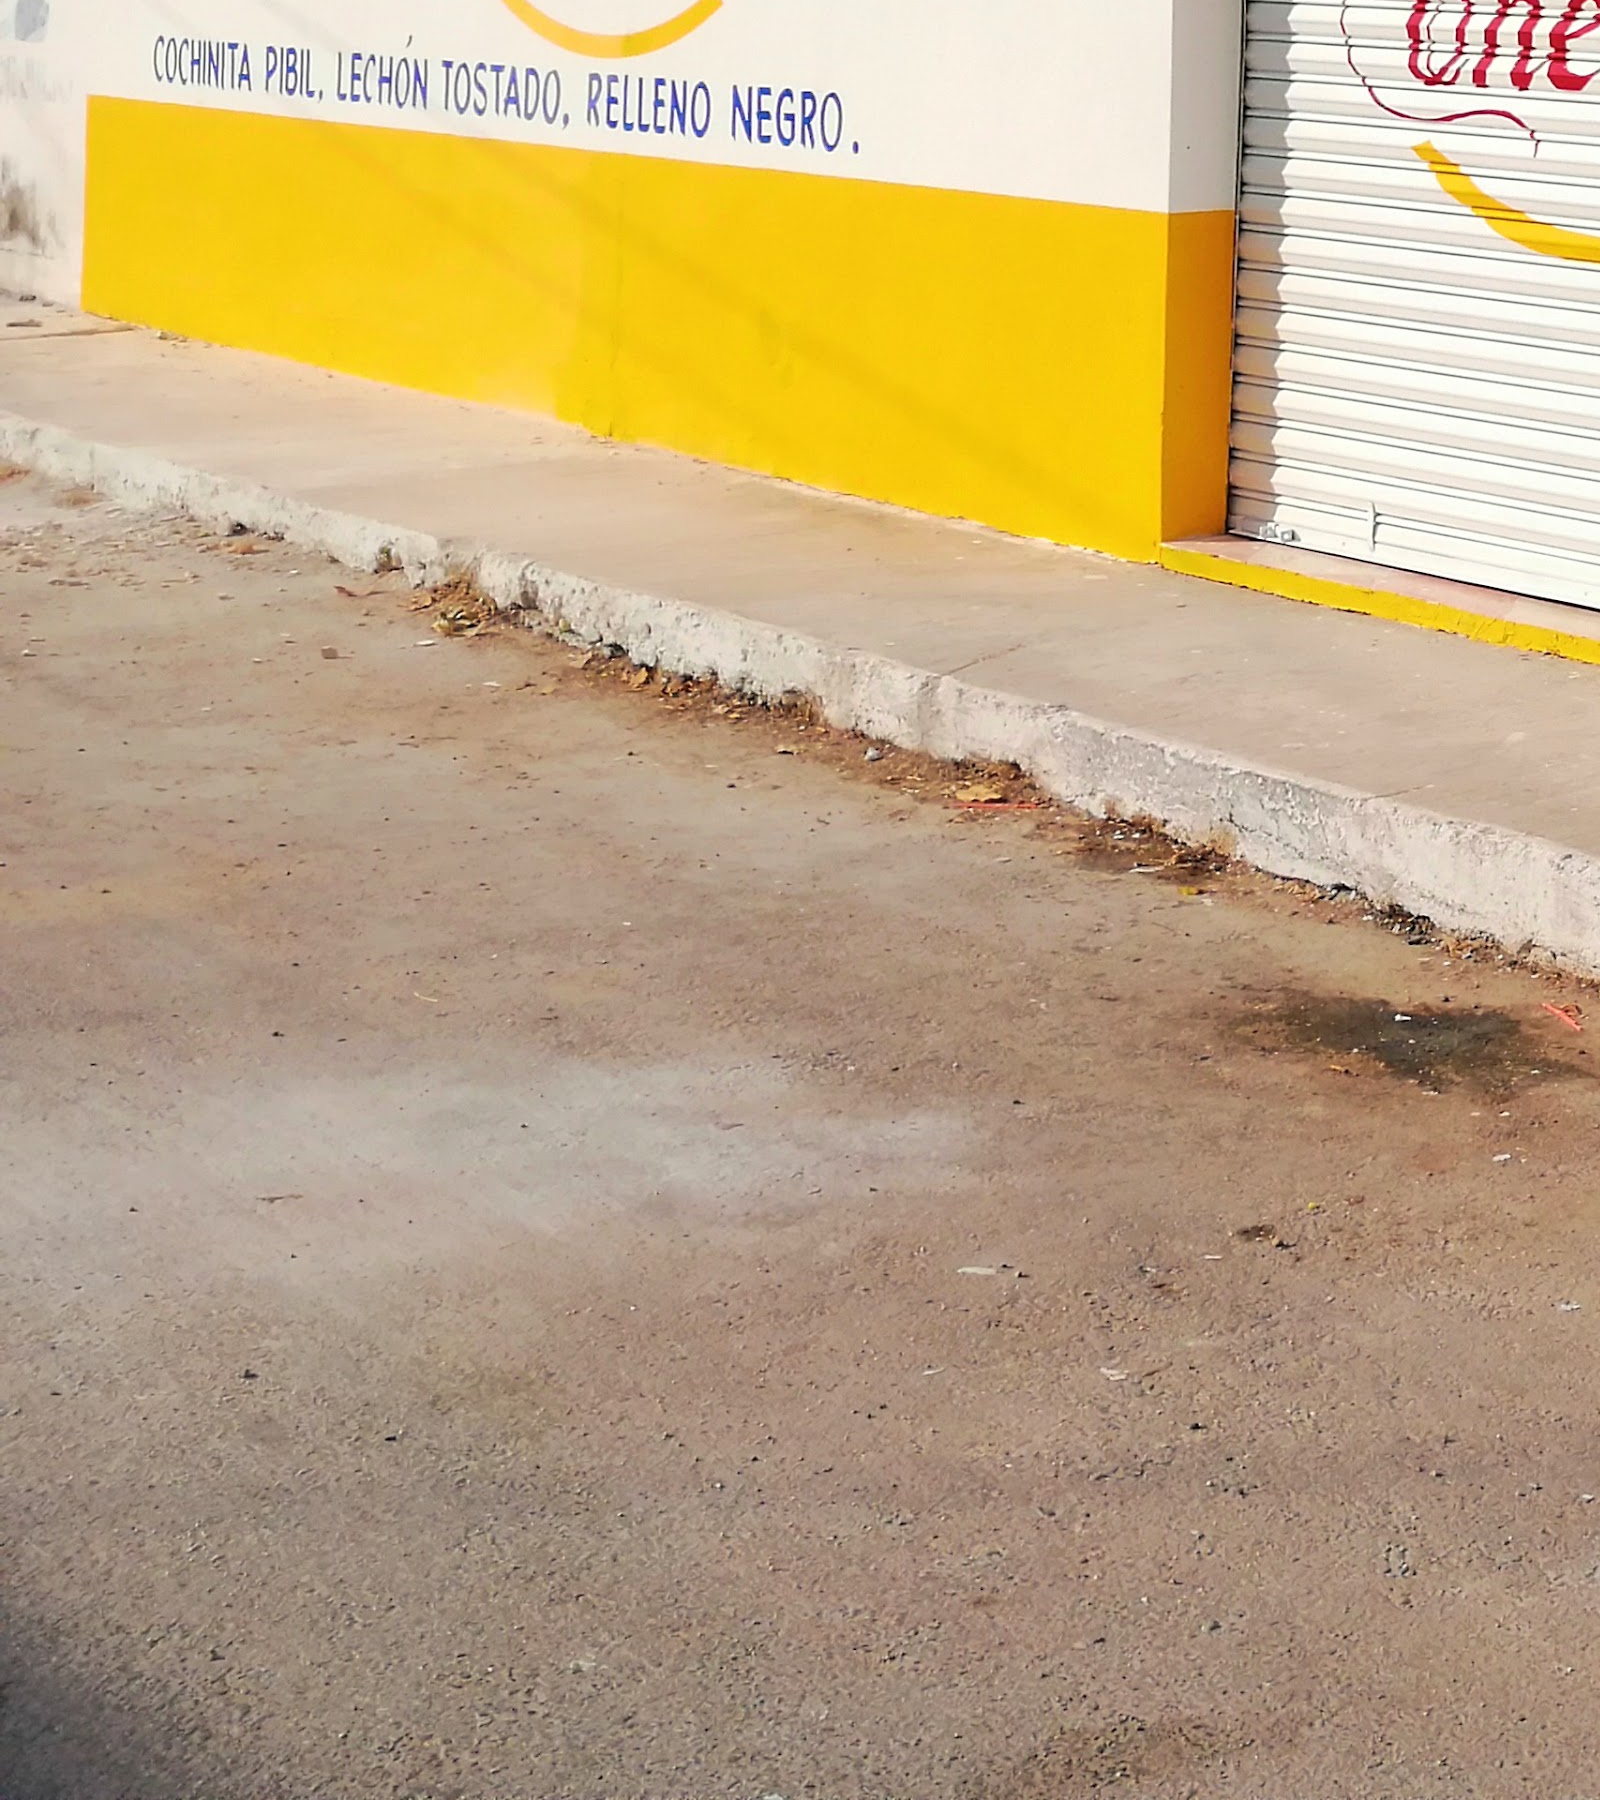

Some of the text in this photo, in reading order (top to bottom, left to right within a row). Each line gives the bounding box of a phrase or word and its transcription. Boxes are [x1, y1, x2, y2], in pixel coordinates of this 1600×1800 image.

[152, 35, 253, 93] COCHINITA
[264, 45, 324, 104] PIBIL,
[335, 34, 430, 111] LECHÓN
[441, 59, 571, 130] TOSTADO,
[586, 71, 712, 139] RELLENO
[730, 83, 861, 155] NEGRO.
